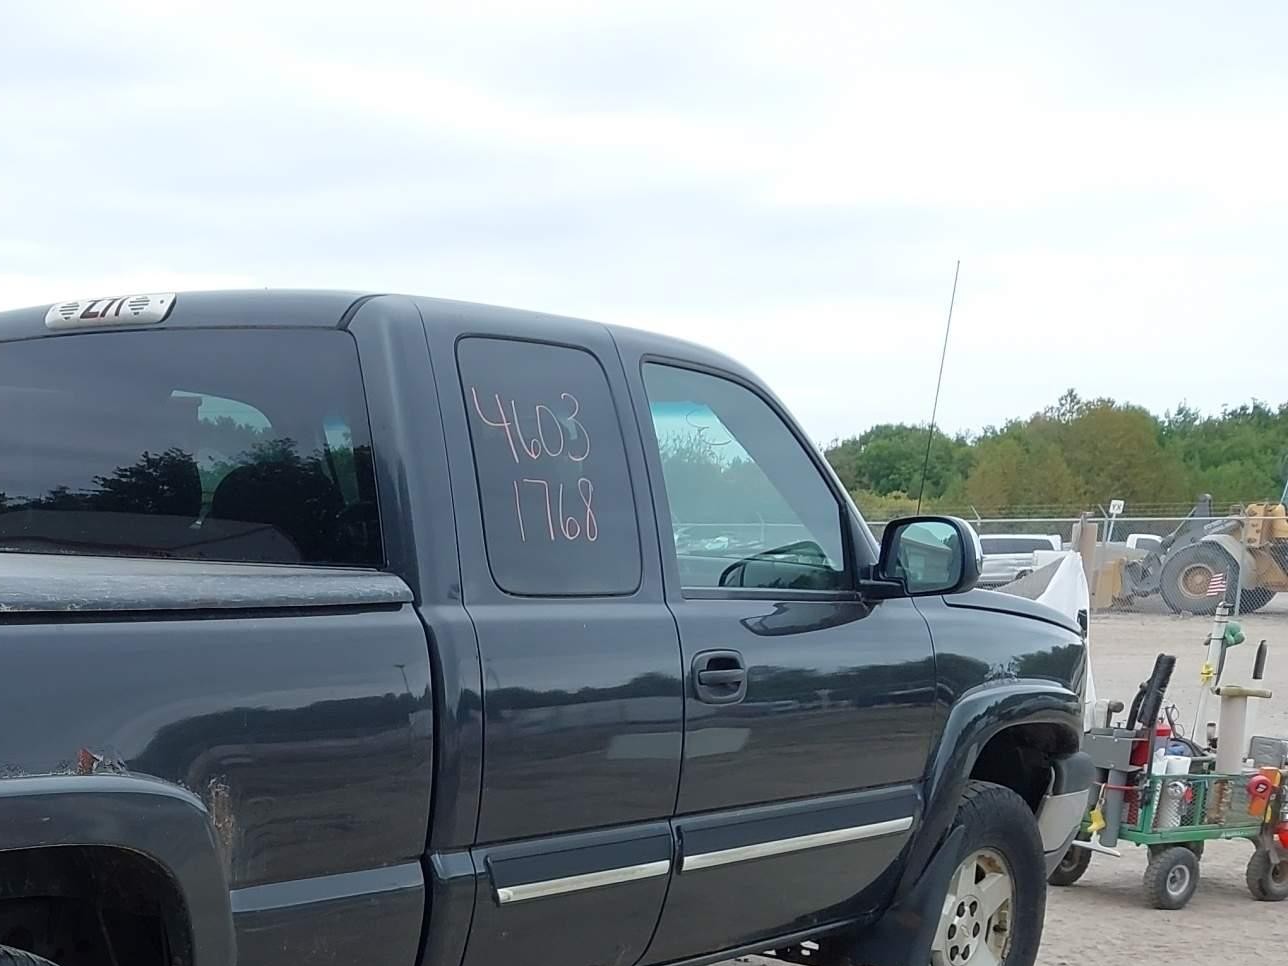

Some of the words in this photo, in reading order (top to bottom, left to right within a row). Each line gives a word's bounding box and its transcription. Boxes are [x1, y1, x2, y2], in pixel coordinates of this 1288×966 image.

[79, 298, 128, 319] Z71
[471, 386, 591, 464] 4603
[512, 477, 599, 542] 1768
